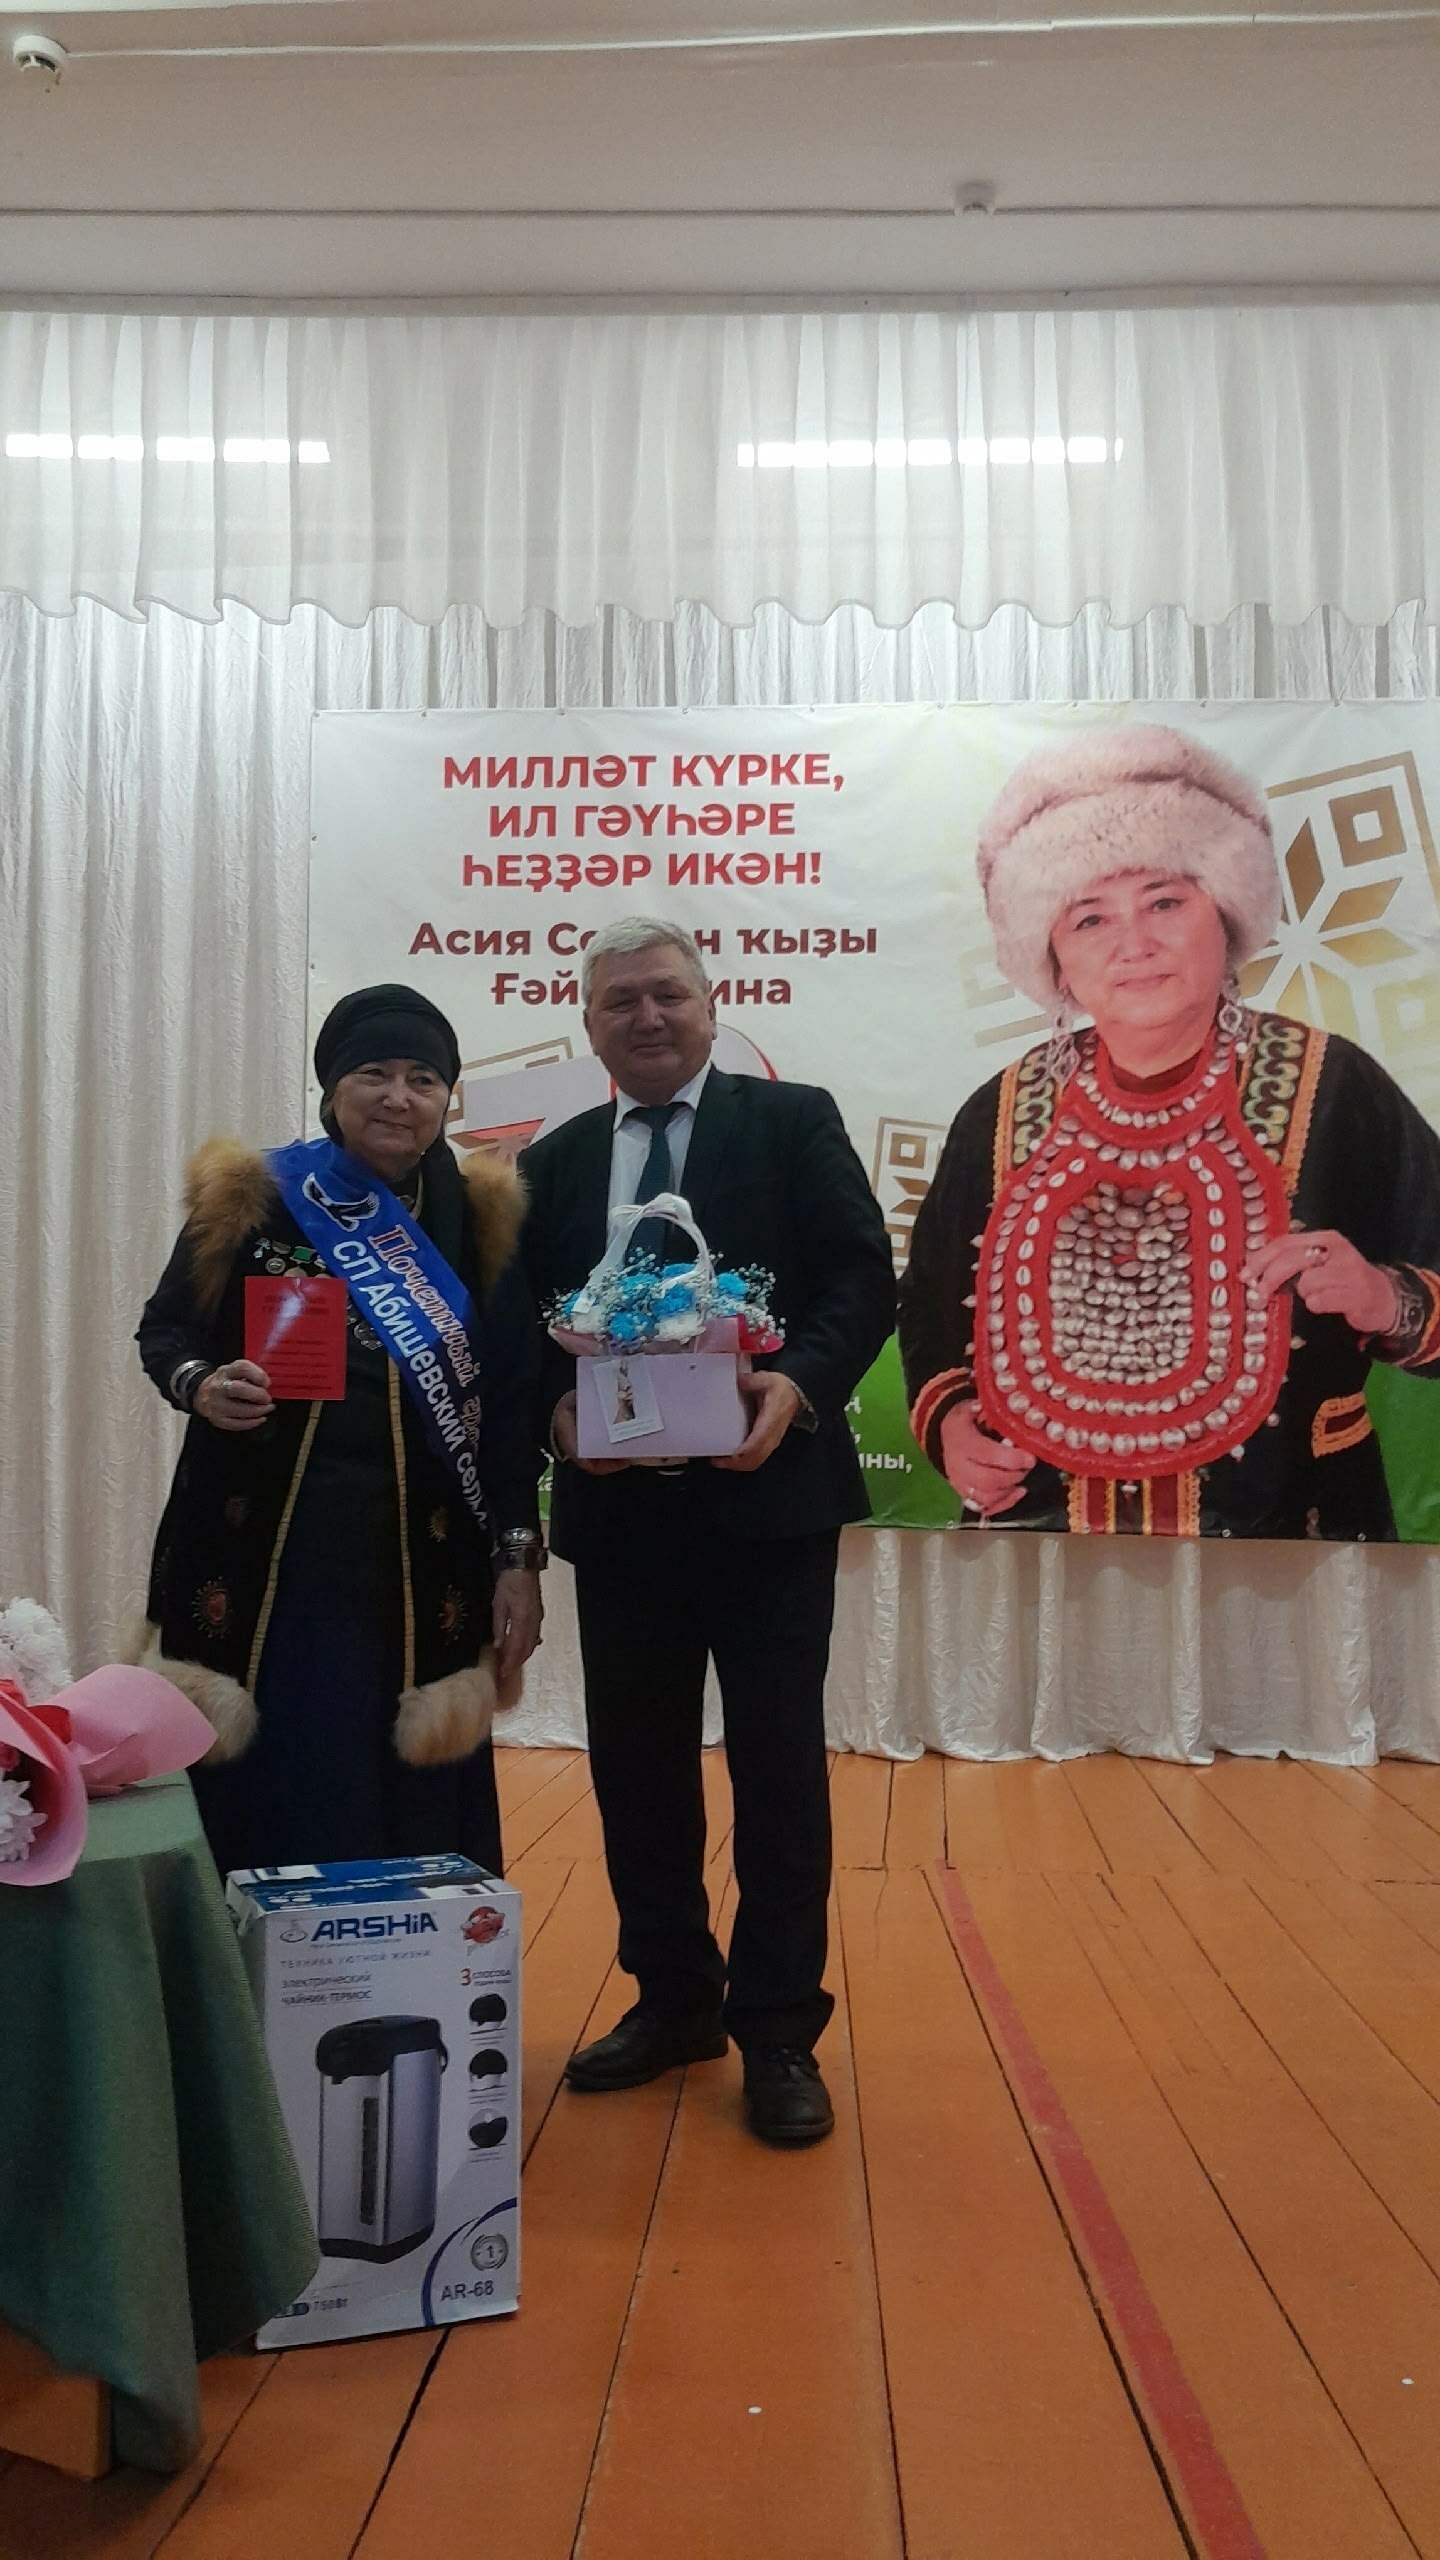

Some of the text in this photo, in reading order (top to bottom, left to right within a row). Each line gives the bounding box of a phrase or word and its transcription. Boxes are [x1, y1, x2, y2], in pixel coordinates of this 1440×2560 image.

[443, 752, 844, 791] МИЛЛӘТ КҮРКЕ,
[488, 802, 795, 838] ИЛ ГӘҮҺӘРЕ
[462, 851, 822, 893] ҺЕҘҘӘР ИКӘН!
[409, 922, 531, 956] Асия
[736, 928, 877, 958] ҡыҙы
[367, 1224, 481, 1388] Почетный
[333, 1240, 380, 1281] СП
[359, 1282, 467, 1453] Абишевский
[460, 1968, 471, 1986] 3
[441, 2280, 495, 2302] AR-68
